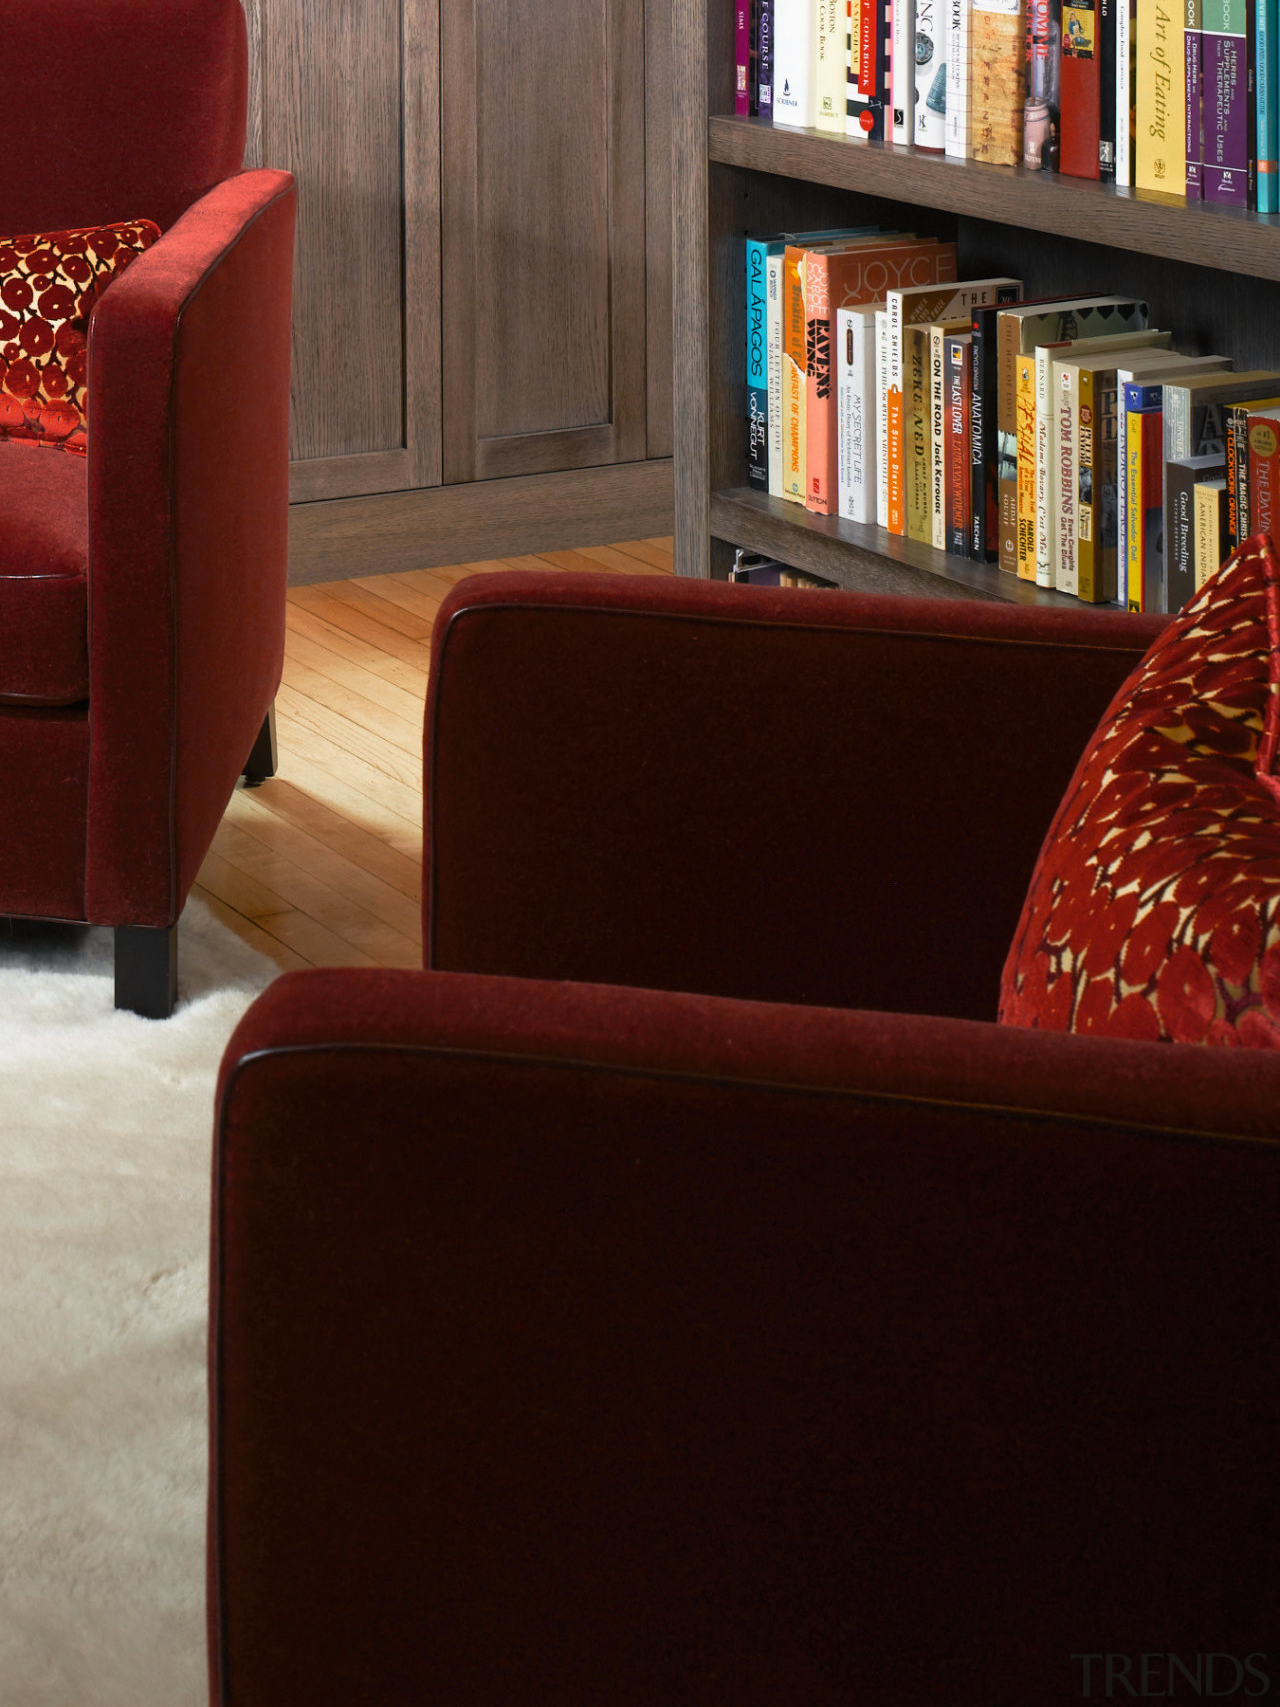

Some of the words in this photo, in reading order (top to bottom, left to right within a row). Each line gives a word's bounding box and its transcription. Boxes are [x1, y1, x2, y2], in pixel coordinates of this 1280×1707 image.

[1155, 5, 1172, 40] Art
[761, 13, 769, 70] COURSE
[1150, 47, 1172, 74] of
[1223, 40, 1231, 115] SUPPLEMENTS
[1149, 72, 1171, 142] Eating
[1216, 61, 1224, 131] THERAPEUTIC
[1216, 134, 1224, 162] USES
[843, 253, 954, 295] JOYCE
[750, 249, 766, 377] GALÁPAGOS
[961, 291, 988, 306] THE
[891, 334, 899, 377] SHIELDS
[933, 358, 941, 377] ON
[934, 378, 942, 398] THE
[951, 386, 963, 407] LAST
[749, 391, 759, 461] VONNEGUT
[757, 411, 766, 446] KURT
[891, 406, 900, 424] The
[934, 404, 942, 437] ROAD
[952, 408, 963, 435] LOVER
[972, 392, 983, 465] ANATOMICA
[1060, 406, 1072, 443] TOM
[790, 416, 800, 474] CHAMPIONS
[852, 412, 862, 461] SECRET
[891, 429, 899, 455] Stone
[934, 442, 942, 467] Jack
[1227, 436, 1237, 495] CLOCKWORK
[853, 461, 863, 484] LIFE
[891, 464, 900, 502] Diaries
[1060, 446, 1073, 516] ROBBINS
[1238, 463, 1248, 482] THE
[1258, 460, 1271, 488] THE
[934, 469, 943, 515] Kerouac
[1179, 491, 1189, 522] Good
[1238, 482, 1248, 510] MAGIC
[1258, 489, 1272, 510] DA
[1199, 502, 1208, 548] AMERICAN
[1228, 497, 1237, 536] ORANGE
[1018, 518, 1027, 562] SCHECHTER
[1026, 520, 1035, 554] HAROLD
[1178, 523, 1190, 574] Breeding
[1200, 550, 1208, 585] INDIAN
